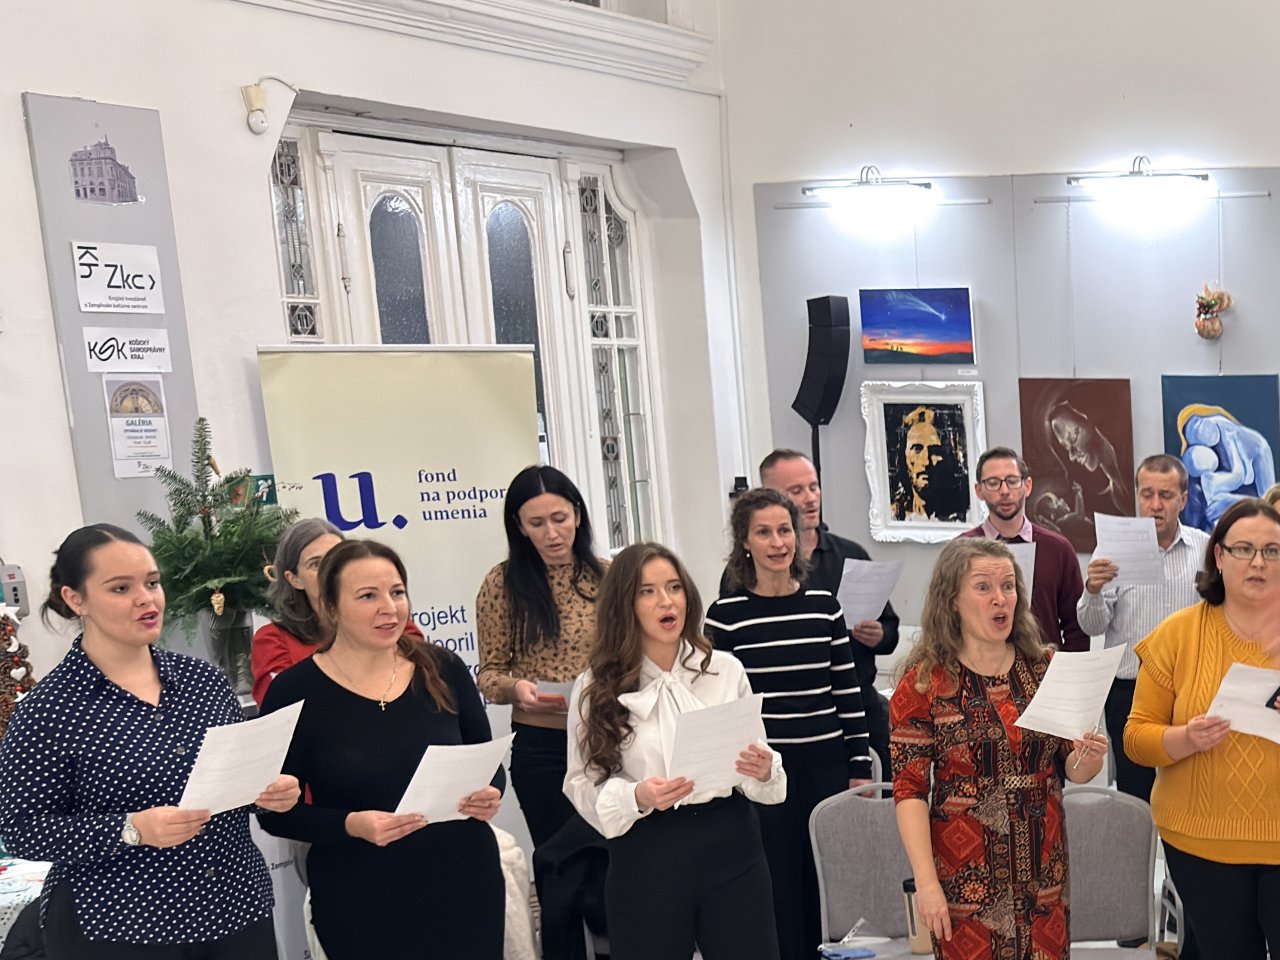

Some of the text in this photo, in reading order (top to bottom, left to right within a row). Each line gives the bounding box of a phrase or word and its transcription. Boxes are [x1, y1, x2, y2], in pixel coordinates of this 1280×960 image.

[88, 337, 128, 361] KSK
[418, 468, 457, 484] fond
[420, 486, 507, 504] na podpor
[422, 505, 488, 521] umenia
[411, 605, 468, 631] rojekt
